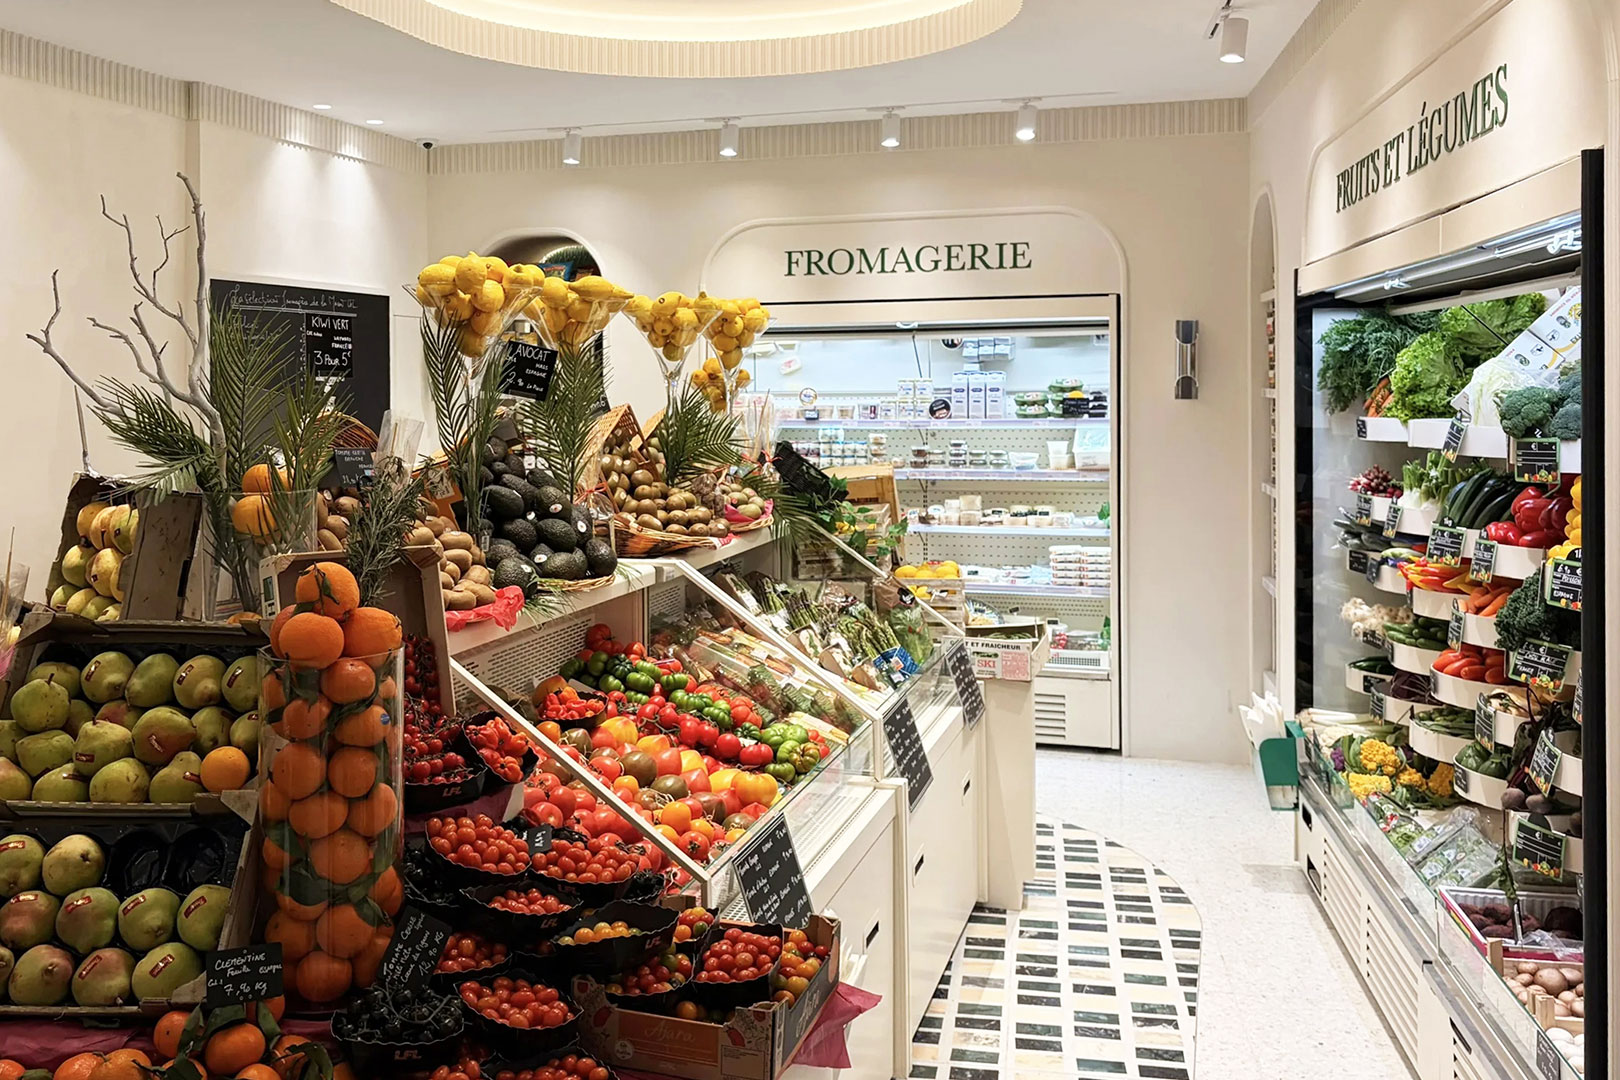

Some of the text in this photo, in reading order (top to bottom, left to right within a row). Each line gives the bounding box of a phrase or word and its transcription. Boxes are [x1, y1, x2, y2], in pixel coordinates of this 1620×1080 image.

[1336, 63, 1509, 213] FRUITS ET LÉGUMES
[784, 242, 1032, 277] FROMAGERIE
[311, 315, 350, 330] KIWI VERT
[313, 350, 324, 365] 3
[516, 344, 551, 361] AVOCAT
[981, 642, 1021, 650] FRAICHEUR
[977, 659, 996, 668] SKI
[383, 943, 404, 975] TOMATE
